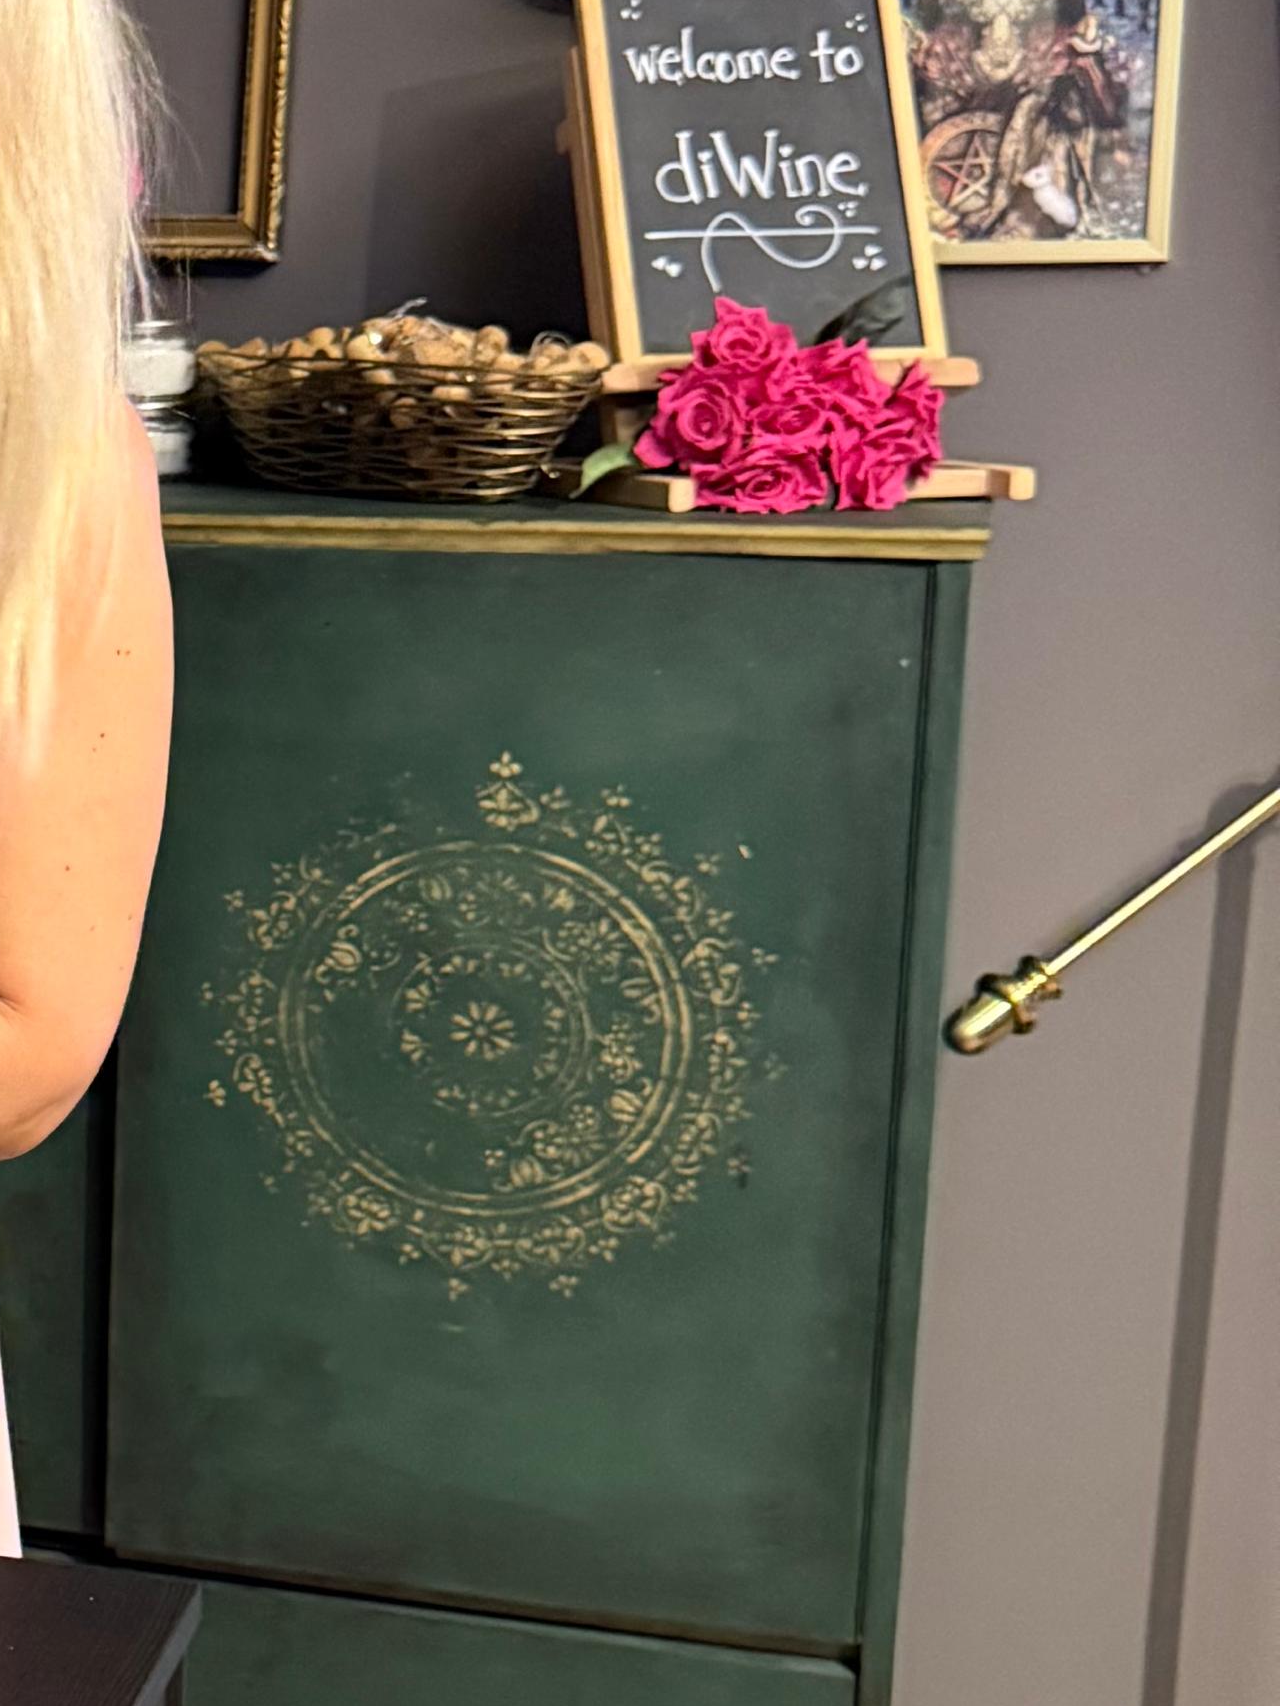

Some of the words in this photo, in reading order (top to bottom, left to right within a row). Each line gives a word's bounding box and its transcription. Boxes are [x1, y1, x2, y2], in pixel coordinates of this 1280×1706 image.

[623, 27, 800, 86] welcome
[810, 30, 863, 82] to
[655, 130, 869, 204] diWine
